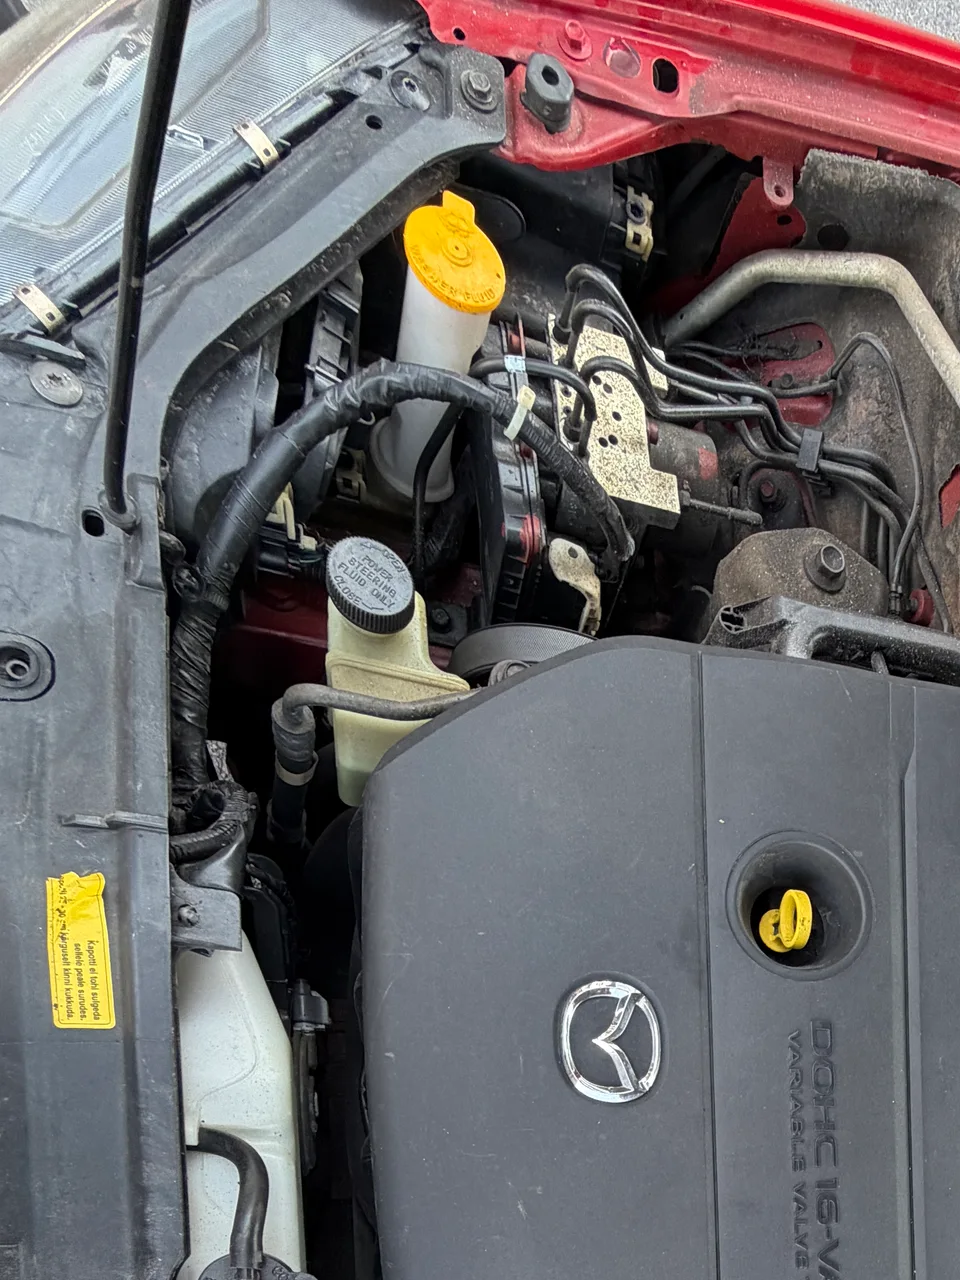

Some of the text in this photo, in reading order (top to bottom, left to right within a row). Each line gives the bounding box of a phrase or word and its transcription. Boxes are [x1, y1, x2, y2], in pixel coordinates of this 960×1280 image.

[348, 557, 397, 598] STEERING
[361, 555, 393, 582] POWER
[382, 549, 406, 573] OPEN
[334, 575, 363, 605] CLOSE
[337, 562, 396, 608] FLUID ONLY
[787, 1029, 808, 1174] VARIABLE
[810, 1019, 839, 1168] DOHC
[792, 1181, 811, 1271] VALVE
